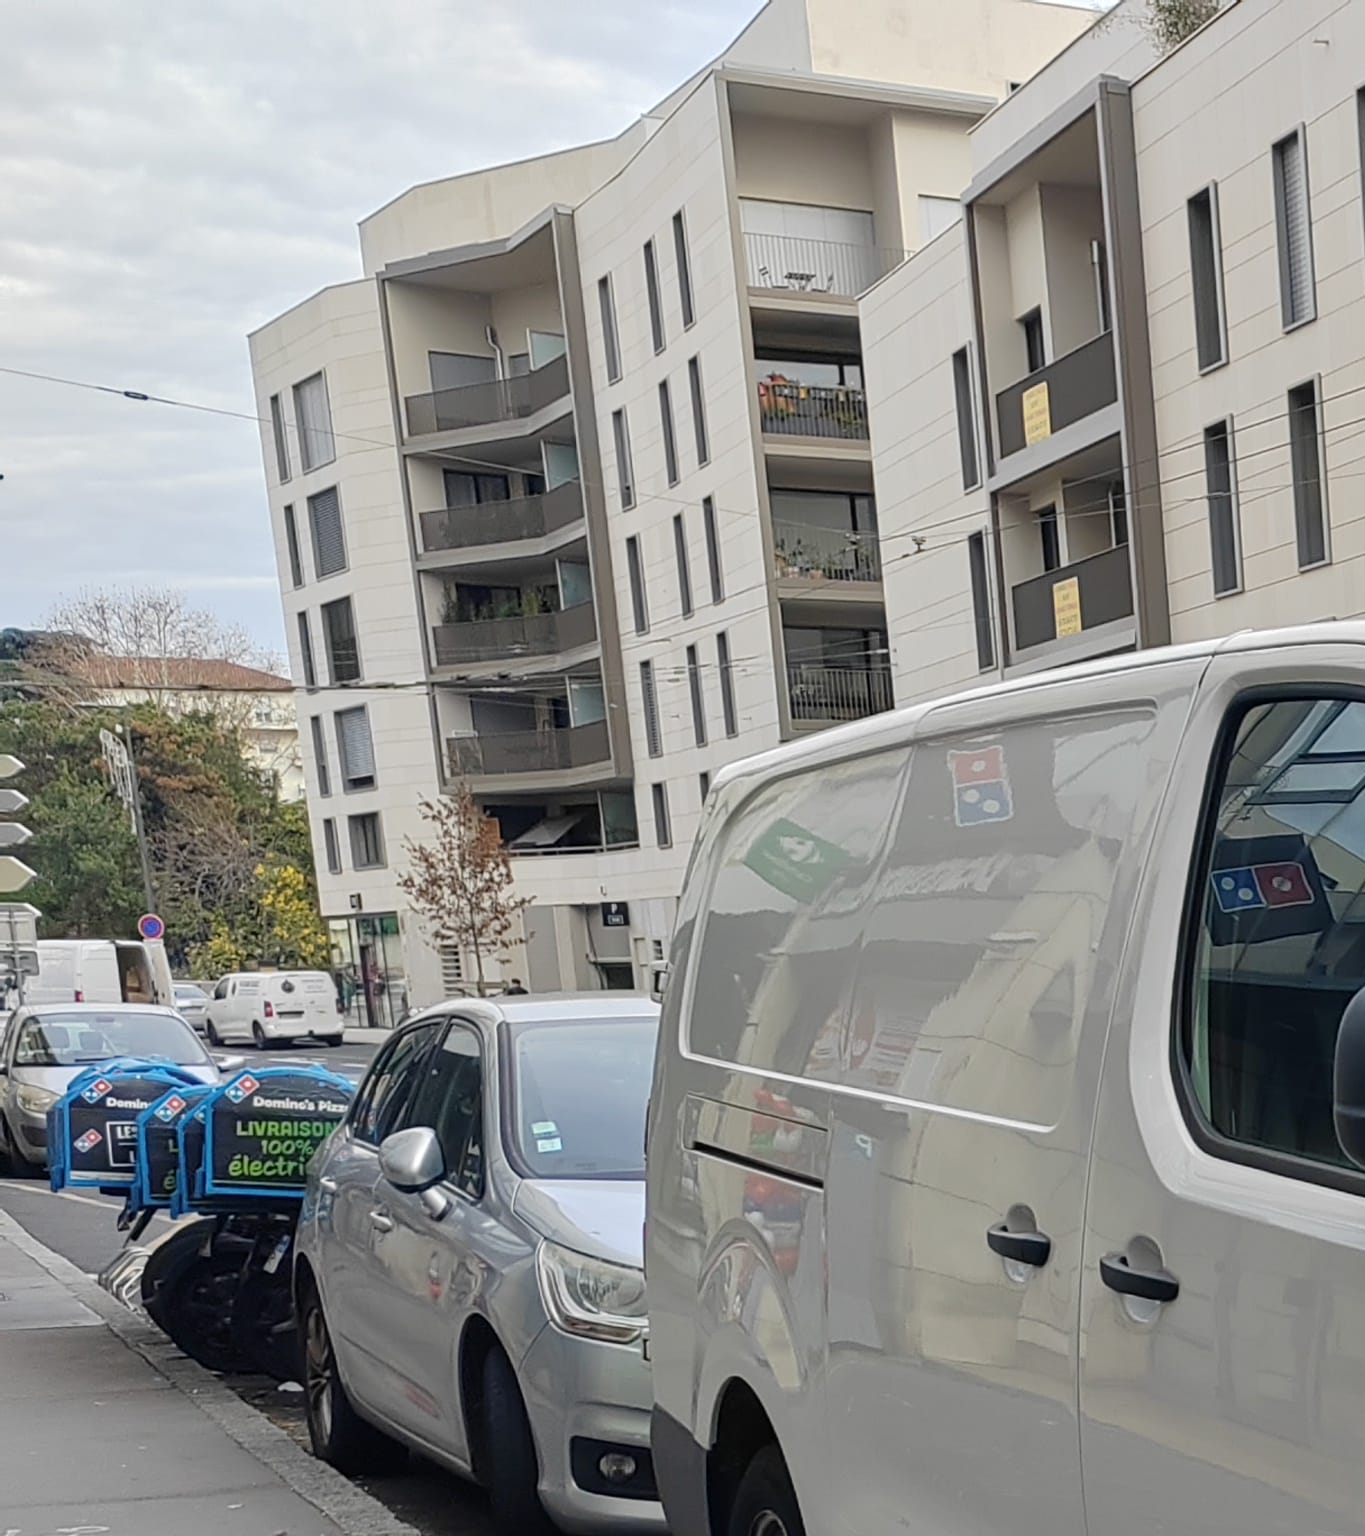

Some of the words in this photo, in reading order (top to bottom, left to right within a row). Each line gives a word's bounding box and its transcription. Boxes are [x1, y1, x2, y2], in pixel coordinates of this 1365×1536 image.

[106, 1097, 151, 1109] Domin
[253, 1096, 315, 1111] Domino's
[236, 1120, 337, 1136] LIVRAISON
[261, 1139, 314, 1155] 100%
